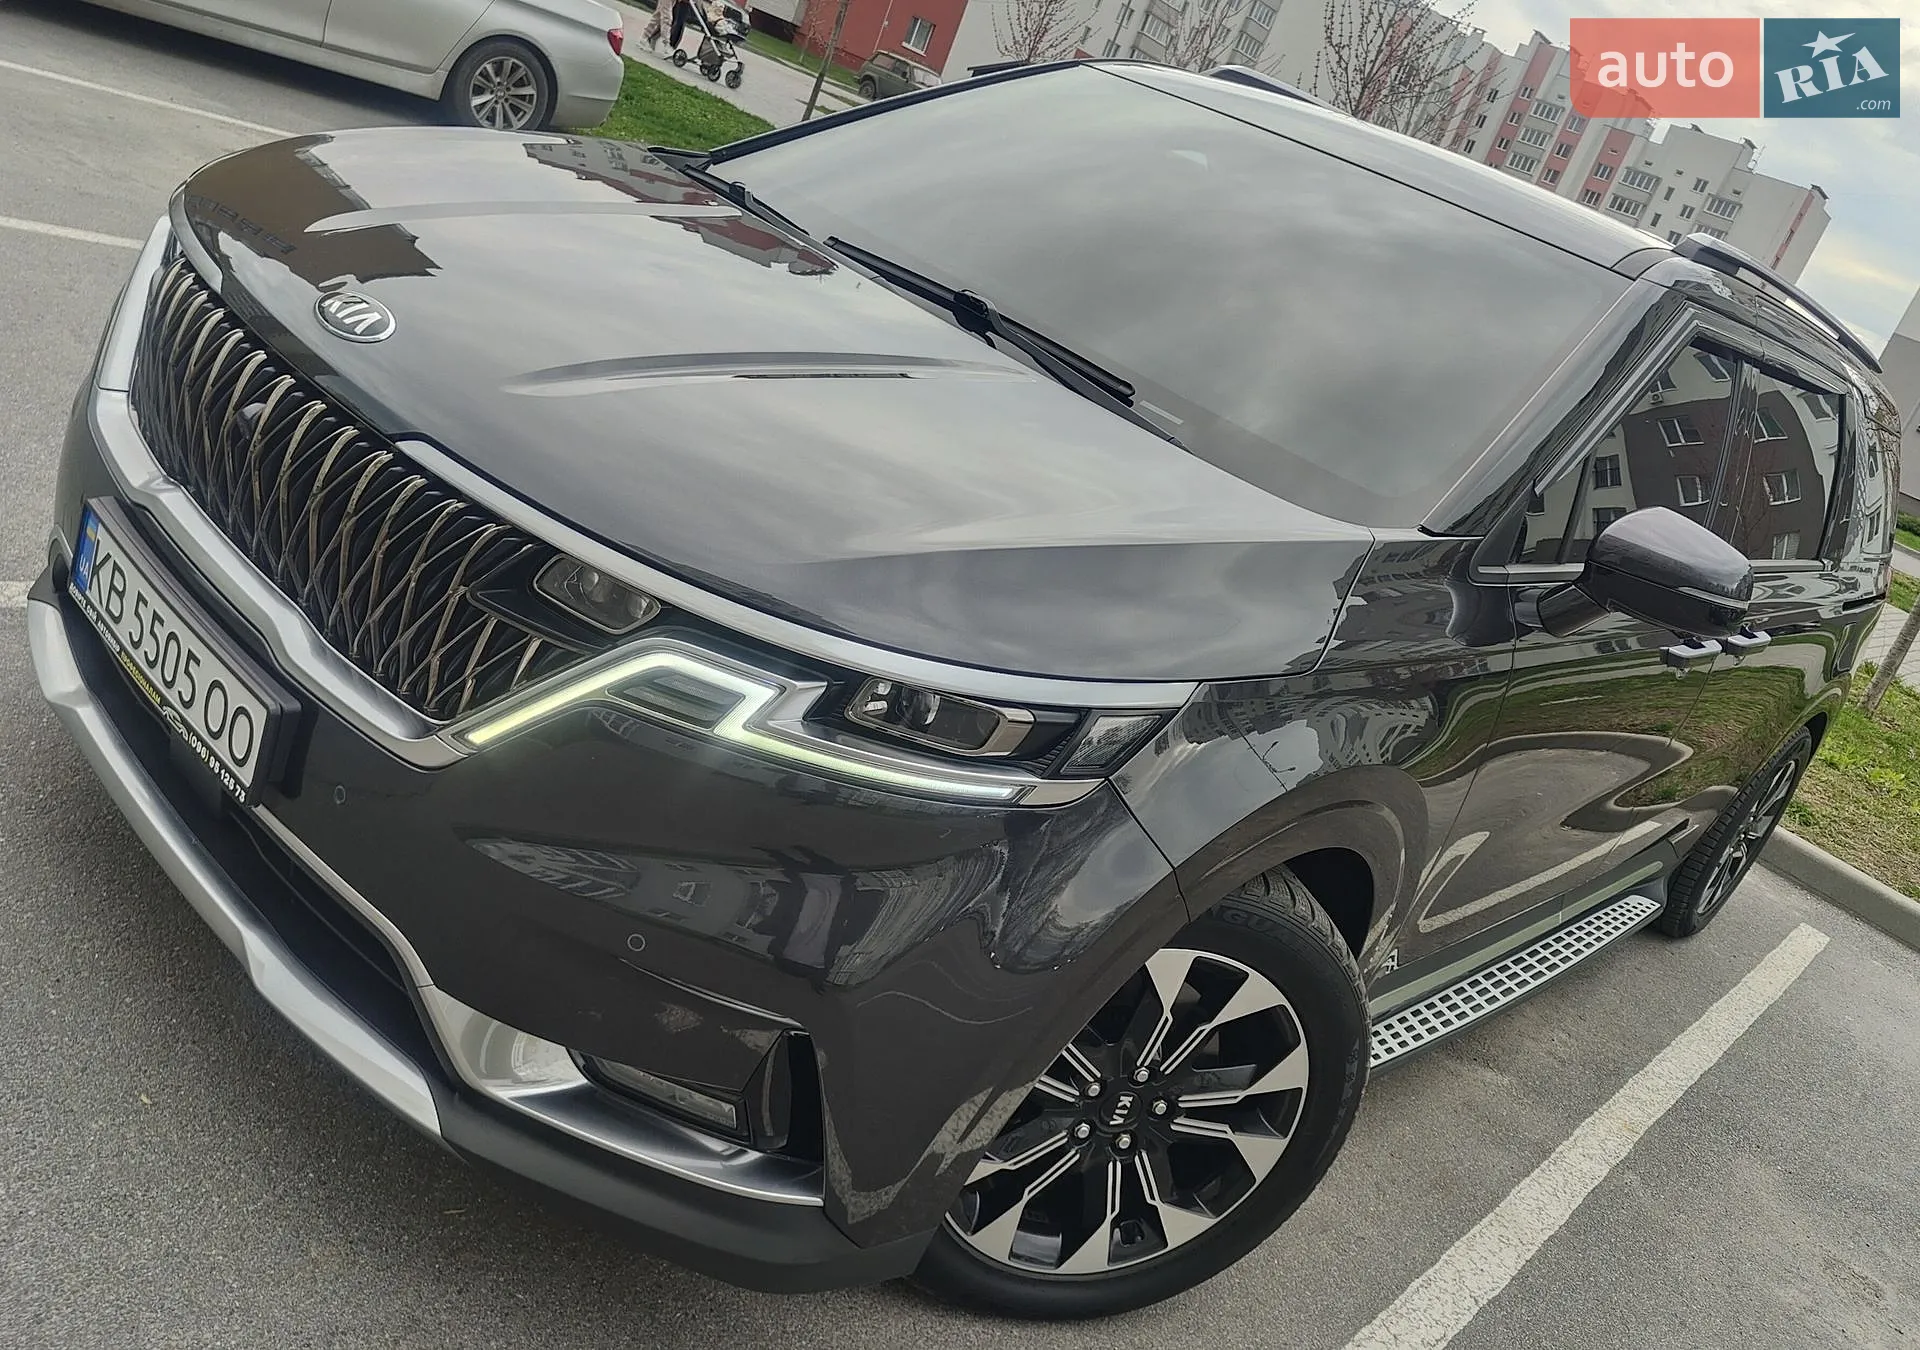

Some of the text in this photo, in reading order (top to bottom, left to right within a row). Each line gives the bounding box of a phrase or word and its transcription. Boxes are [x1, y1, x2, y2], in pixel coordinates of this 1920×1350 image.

[321, 293, 383, 335] KIA
[79, 554, 89, 580] UA
[88, 538, 127, 625] KB
[128, 590, 201, 710] 5505
[1109, 1095, 1134, 1126] KIA
